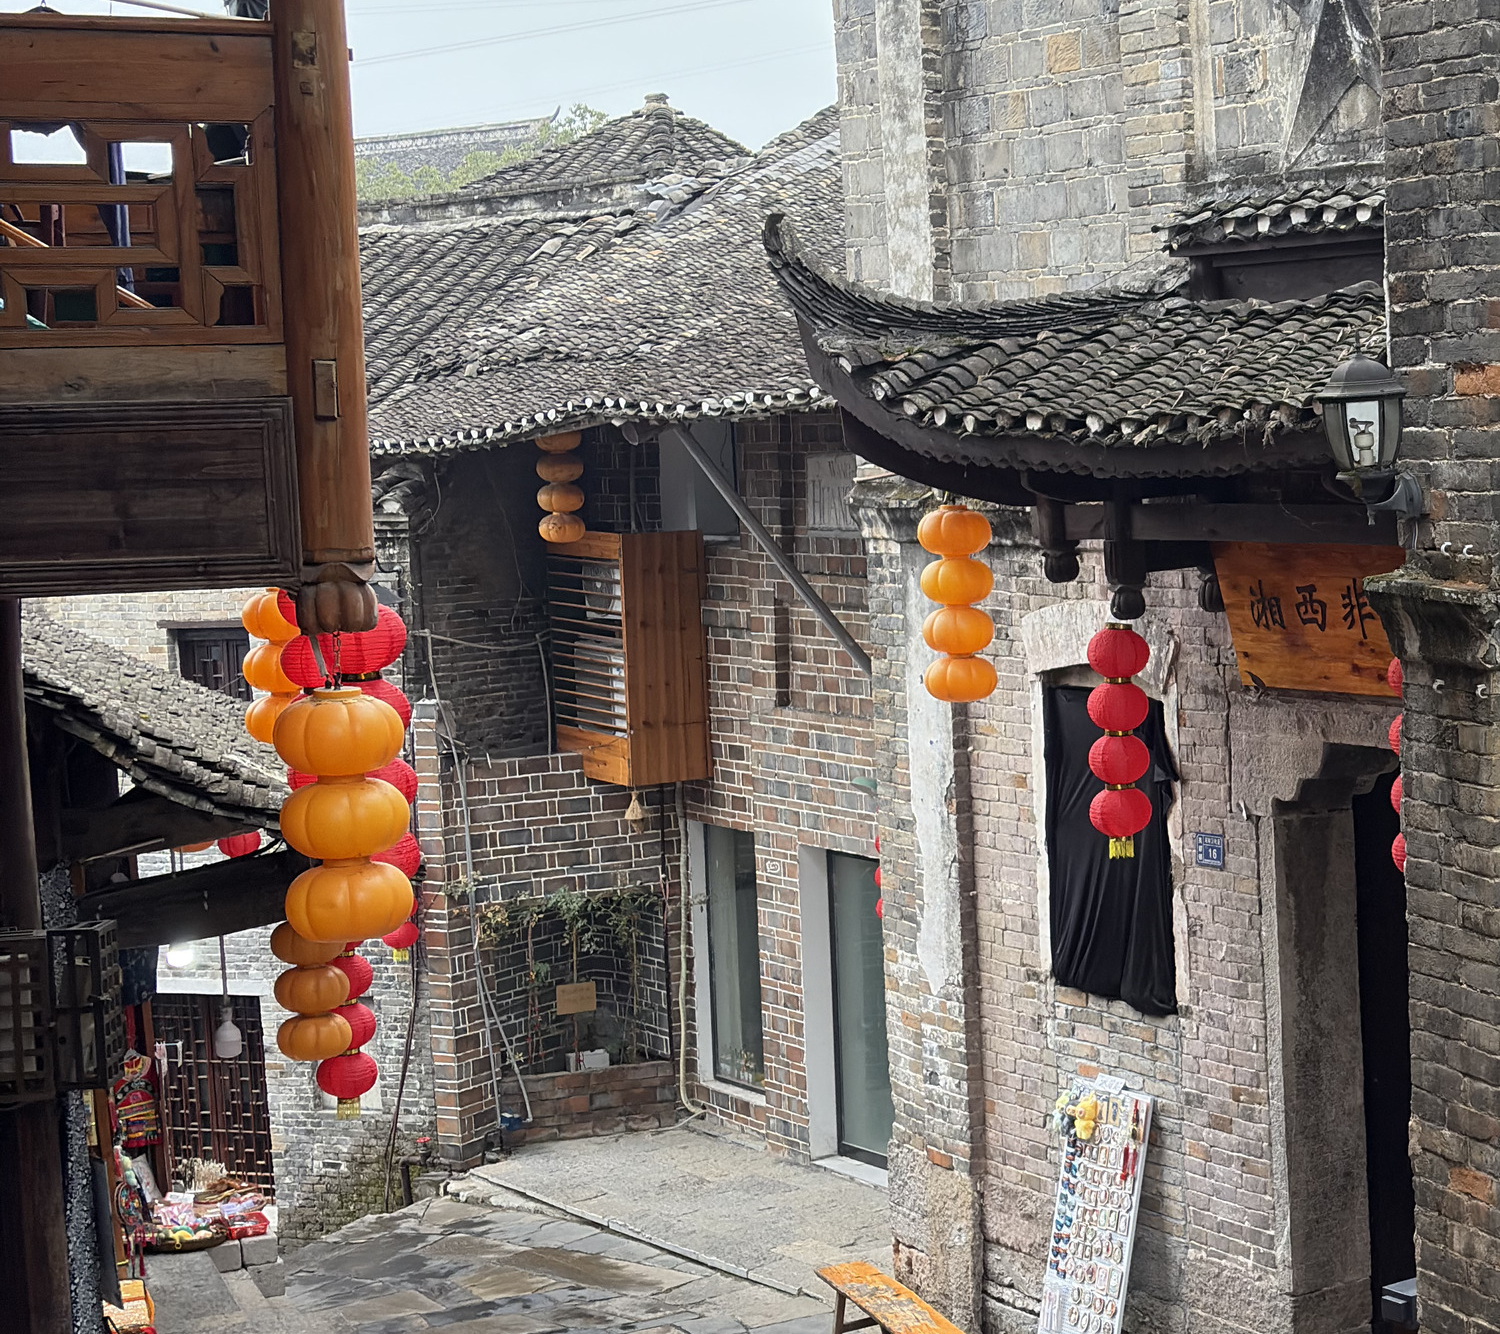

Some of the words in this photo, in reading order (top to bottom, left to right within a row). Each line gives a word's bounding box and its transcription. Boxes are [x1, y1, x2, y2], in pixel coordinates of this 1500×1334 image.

[1249, 578, 1377, 640] 湘西非
[1208, 847, 1217, 859] 16
